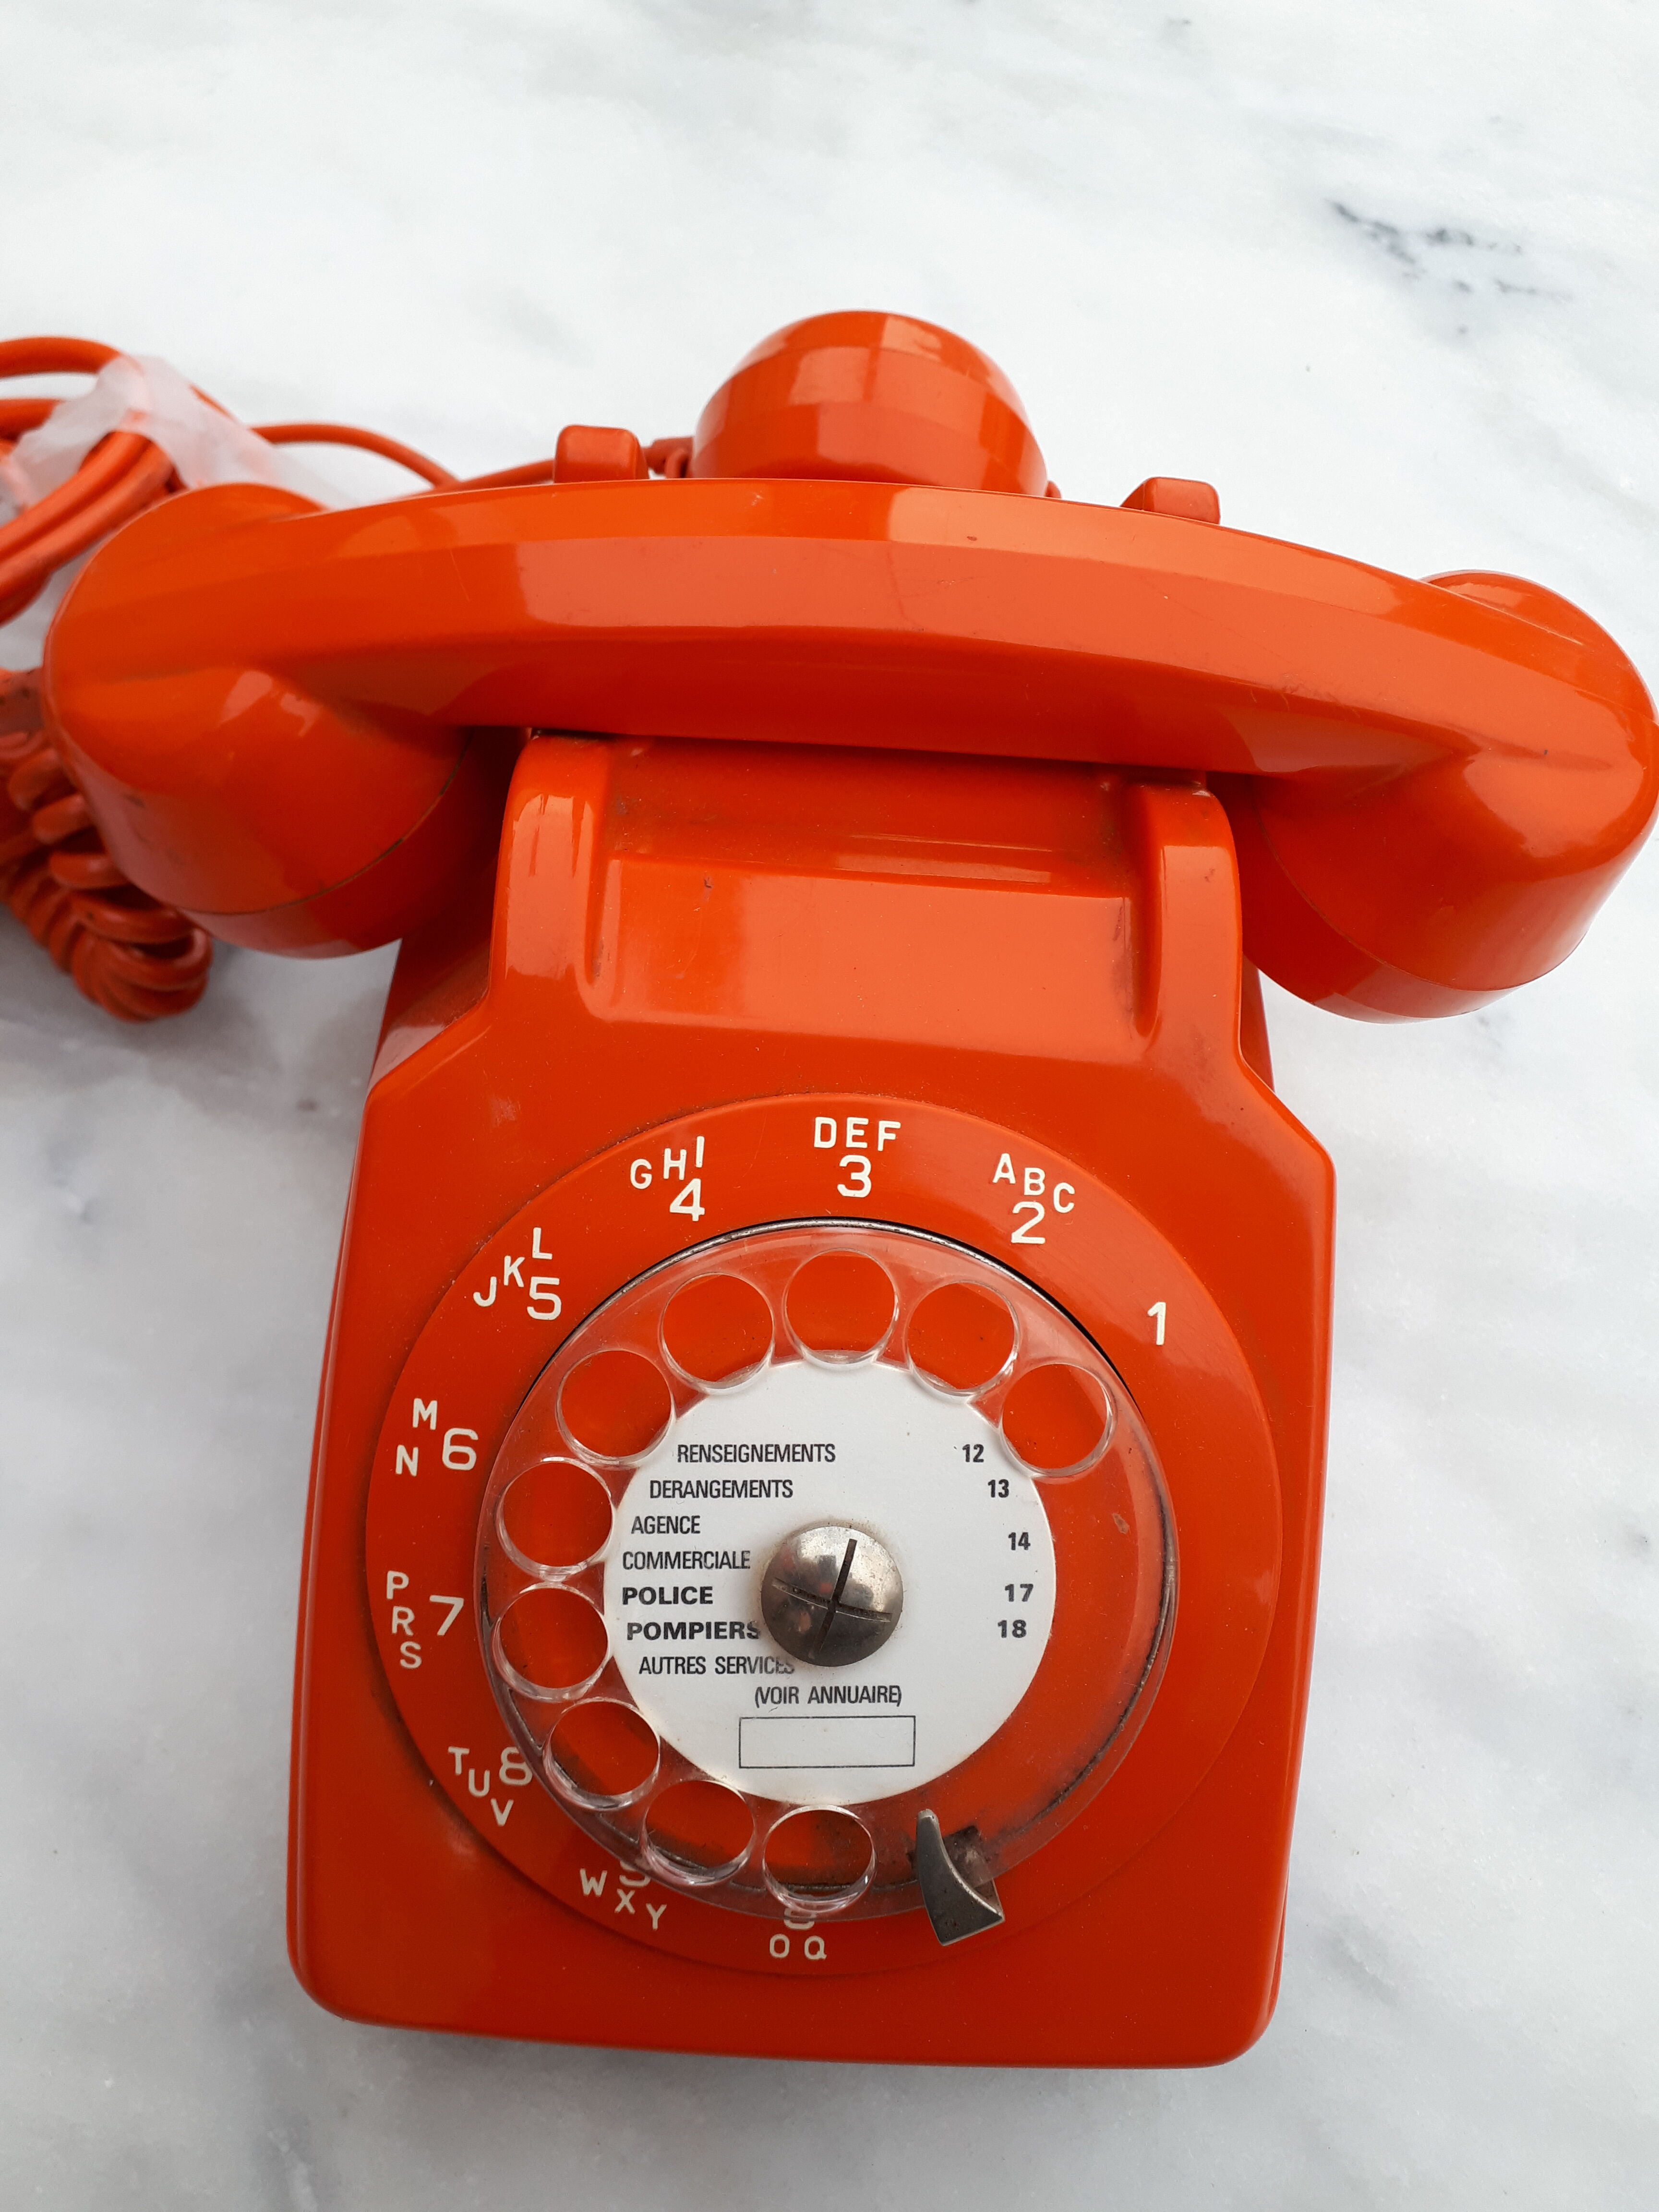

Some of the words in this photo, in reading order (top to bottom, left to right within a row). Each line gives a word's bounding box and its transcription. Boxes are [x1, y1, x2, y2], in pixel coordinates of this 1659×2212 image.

[813, 1116, 902, 1152] DEF
[836, 1154, 872, 1198] 3
[669, 1178, 706, 1222] 4
[1010, 1200, 1046, 1245] 2
[526, 1276, 562, 1321] 5
[1147, 1300, 1167, 1346] 1
[442, 1427, 479, 1471] 6
[677, 1443, 836, 1463] RENSEIGNEMENTS
[962, 1443, 985, 1463] 12
[649, 1479, 793, 1499] DERANGEMENTS
[987, 1479, 1010, 1499] 13
[630, 1515, 701, 1535] AGENCE
[1008, 1531, 1032, 1551] 14
[622, 1550, 751, 1570] COMMERCIALE
[622, 1586, 714, 1606] POLICE
[1004, 1583, 1034, 1603] 17
[429, 1594, 465, 1637] 7
[626, 1621, 761, 1641] POMPIERS
[997, 1619, 1027, 1639] 18
[638, 1655, 707, 1675] AUTRES
[754, 1685, 800, 1709] (VOIR
[807, 1684, 902, 1707] ANNUAIRE)
[499, 1746, 533, 1786] 8
